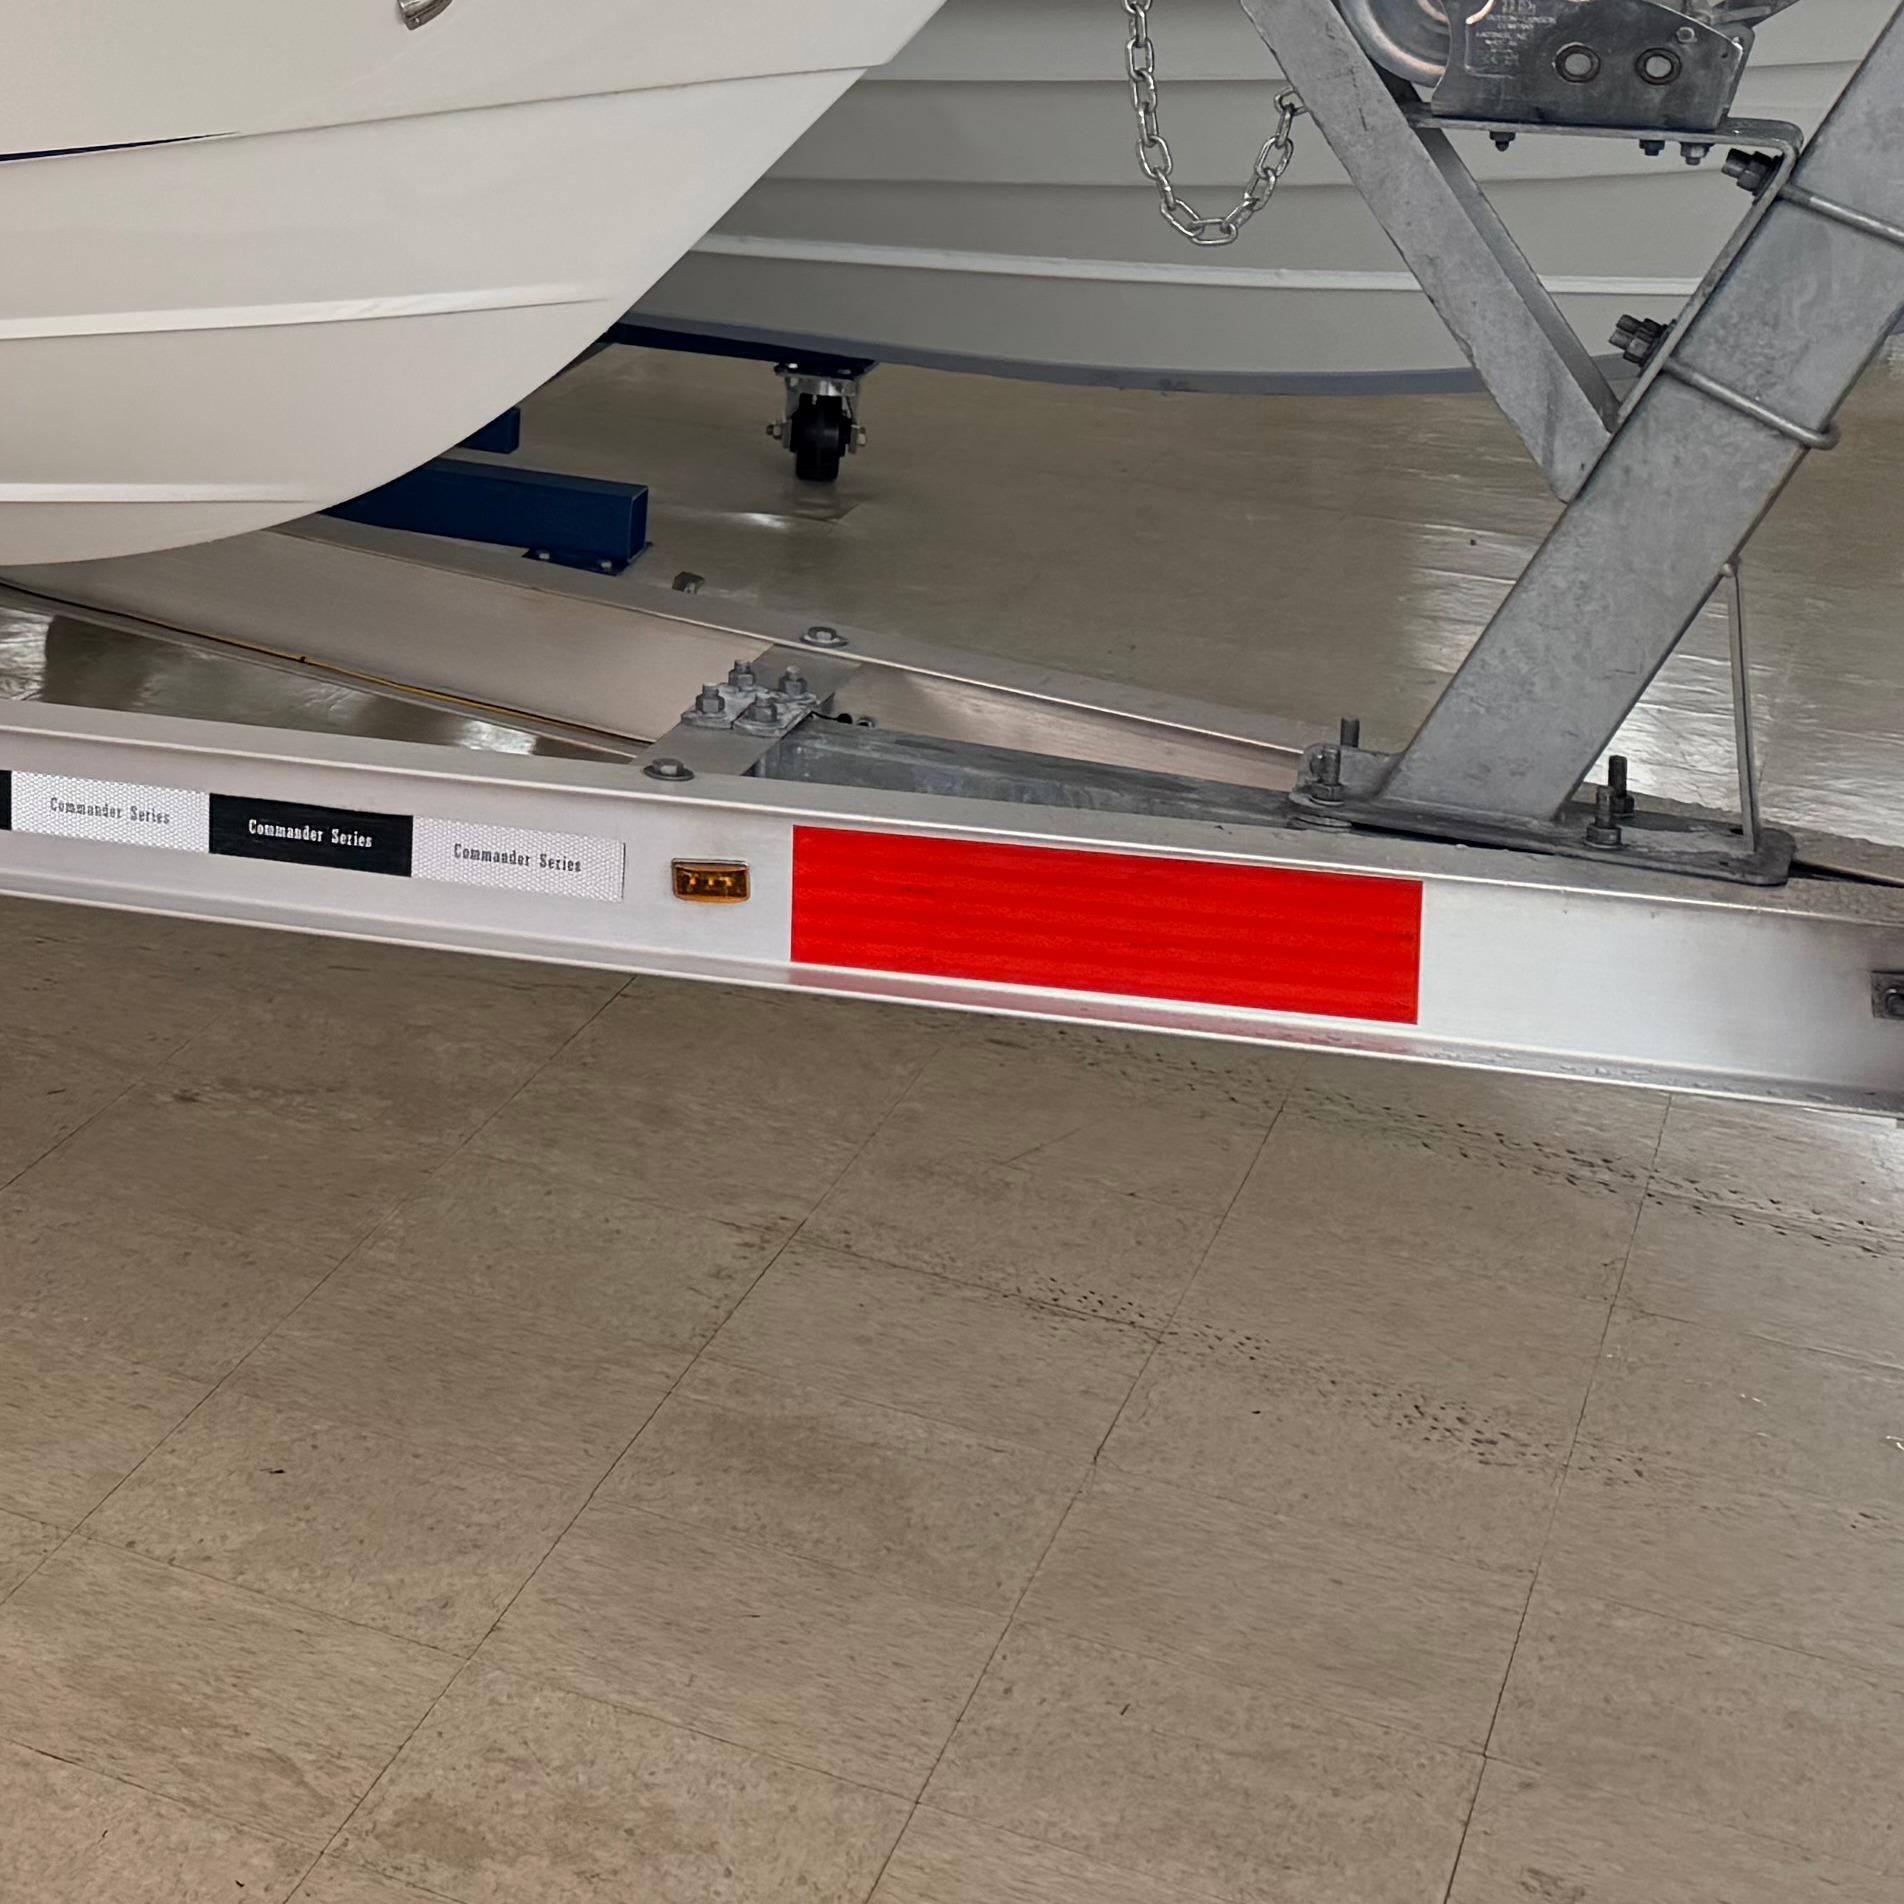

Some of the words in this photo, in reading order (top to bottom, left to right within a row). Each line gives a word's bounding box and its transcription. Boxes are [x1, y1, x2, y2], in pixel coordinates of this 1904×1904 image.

[50, 797, 123, 822] Commander
[129, 805, 169, 826] Series
[248, 819, 324, 847] Commander
[331, 826, 373, 849] Series
[453, 842, 532, 869] Commander
[538, 851, 581, 873] Series
